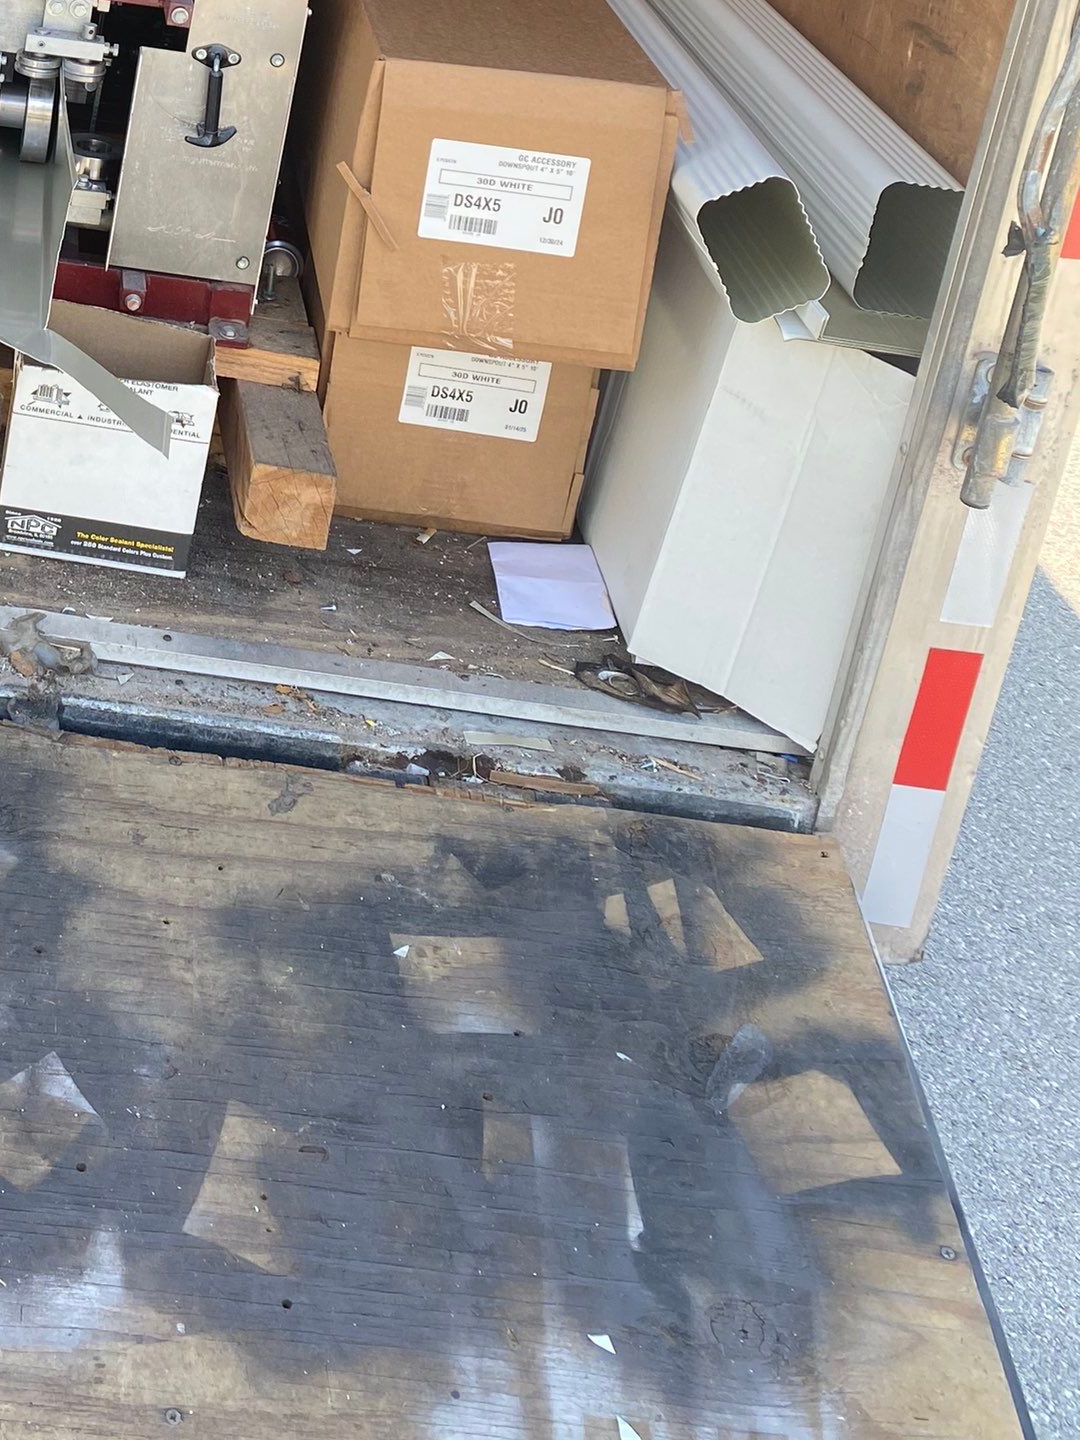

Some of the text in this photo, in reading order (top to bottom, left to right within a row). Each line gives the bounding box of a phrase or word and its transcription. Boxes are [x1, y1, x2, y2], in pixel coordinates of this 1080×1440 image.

[498, 160, 539, 172] DOWNSPOUT
[518, 154, 577, 169] GC ACCESSORY
[476, 177, 535, 192] 30D WHITE
[453, 193, 501, 213] DS4X5
[131, 379, 179, 392] ELASTOMER
[471, 374, 502, 385] WHITE
[129, 386, 154, 396] ALANT
[430, 385, 474, 403] DS4X5
[20, 404, 74, 419] COMMERCIAL
[87, 415, 127, 427] INDUSTR
[76, 531, 89, 540] The
[90, 533, 109, 543] Color
[109, 536, 136, 547] Sealant
[97, 544, 122, 555] Standard
[122, 547, 139, 556] Colors
[140, 549, 152, 558] Plus
